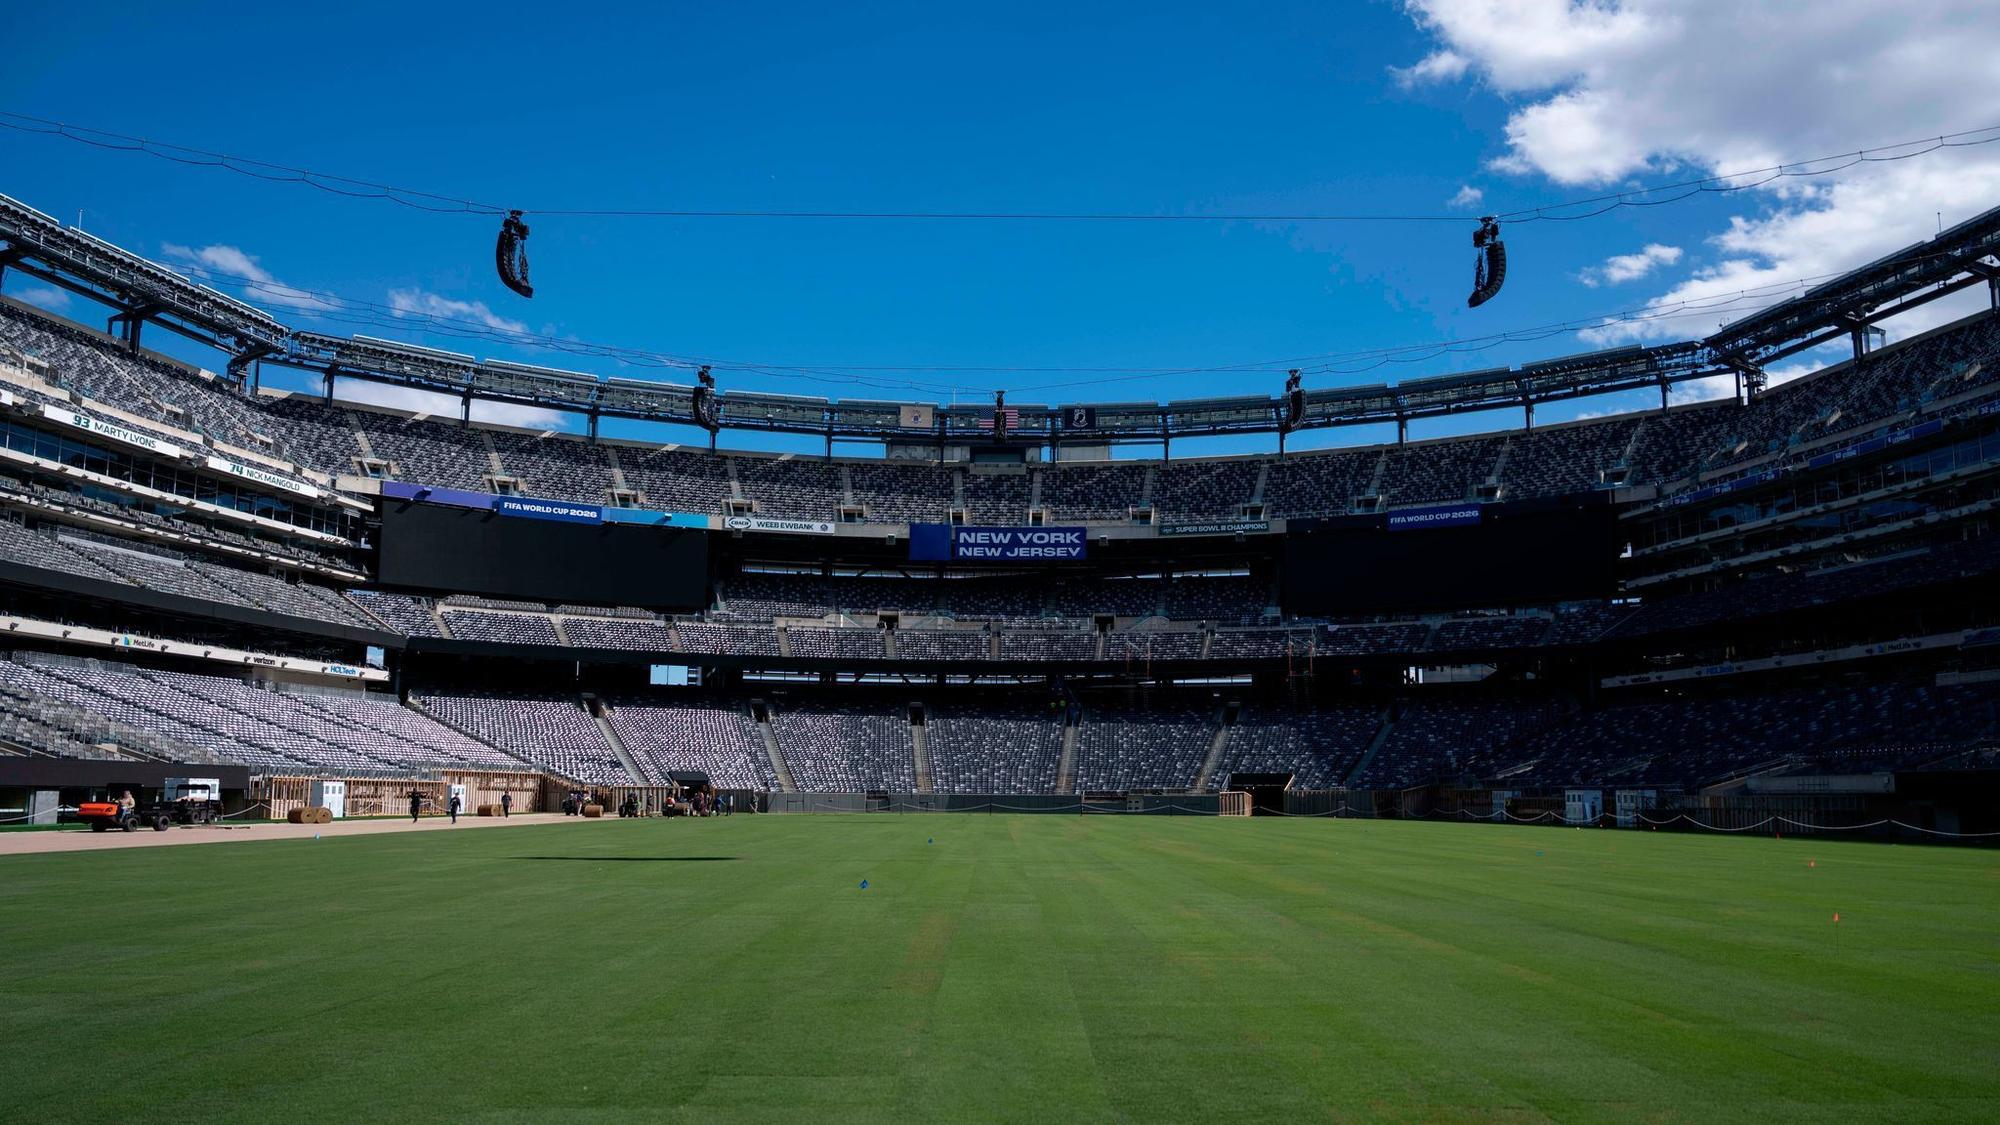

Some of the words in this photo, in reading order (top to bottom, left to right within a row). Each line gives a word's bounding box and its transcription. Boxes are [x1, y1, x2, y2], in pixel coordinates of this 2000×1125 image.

[72, 414, 91, 429] 93
[94, 423, 129, 440] MARTY
[129, 433, 157, 449] LYONS
[229, 463, 243, 475] 74
[246, 469, 264, 481] NICK
[264, 474, 300, 491] MANGOLD
[504, 502, 522, 510] FIFA
[522, 504, 552, 514] WORLD
[552, 507, 569, 516] CUP
[569, 509, 598, 518] 2026
[1390, 516, 1407, 524] FIFA
[1407, 514, 1435, 522] WORLD
[1435, 512, 1451, 520] CUP
[1451, 510, 1479, 519] 2026
[756, 521, 780, 529] WEEB
[780, 522, 814, 530] EWBANK
[1227, 523, 1268, 531] CHAMPIONS
[960, 532, 1012, 544] NEW
[1017, 532, 1081, 544] YORK
[960, 547, 1002, 557] NEW
[1006, 547, 1080, 557] JERSEY
[133, 639, 155, 648] MetLife
[253, 656, 276, 665] verizon
[330, 665, 356, 675] HCLTech
